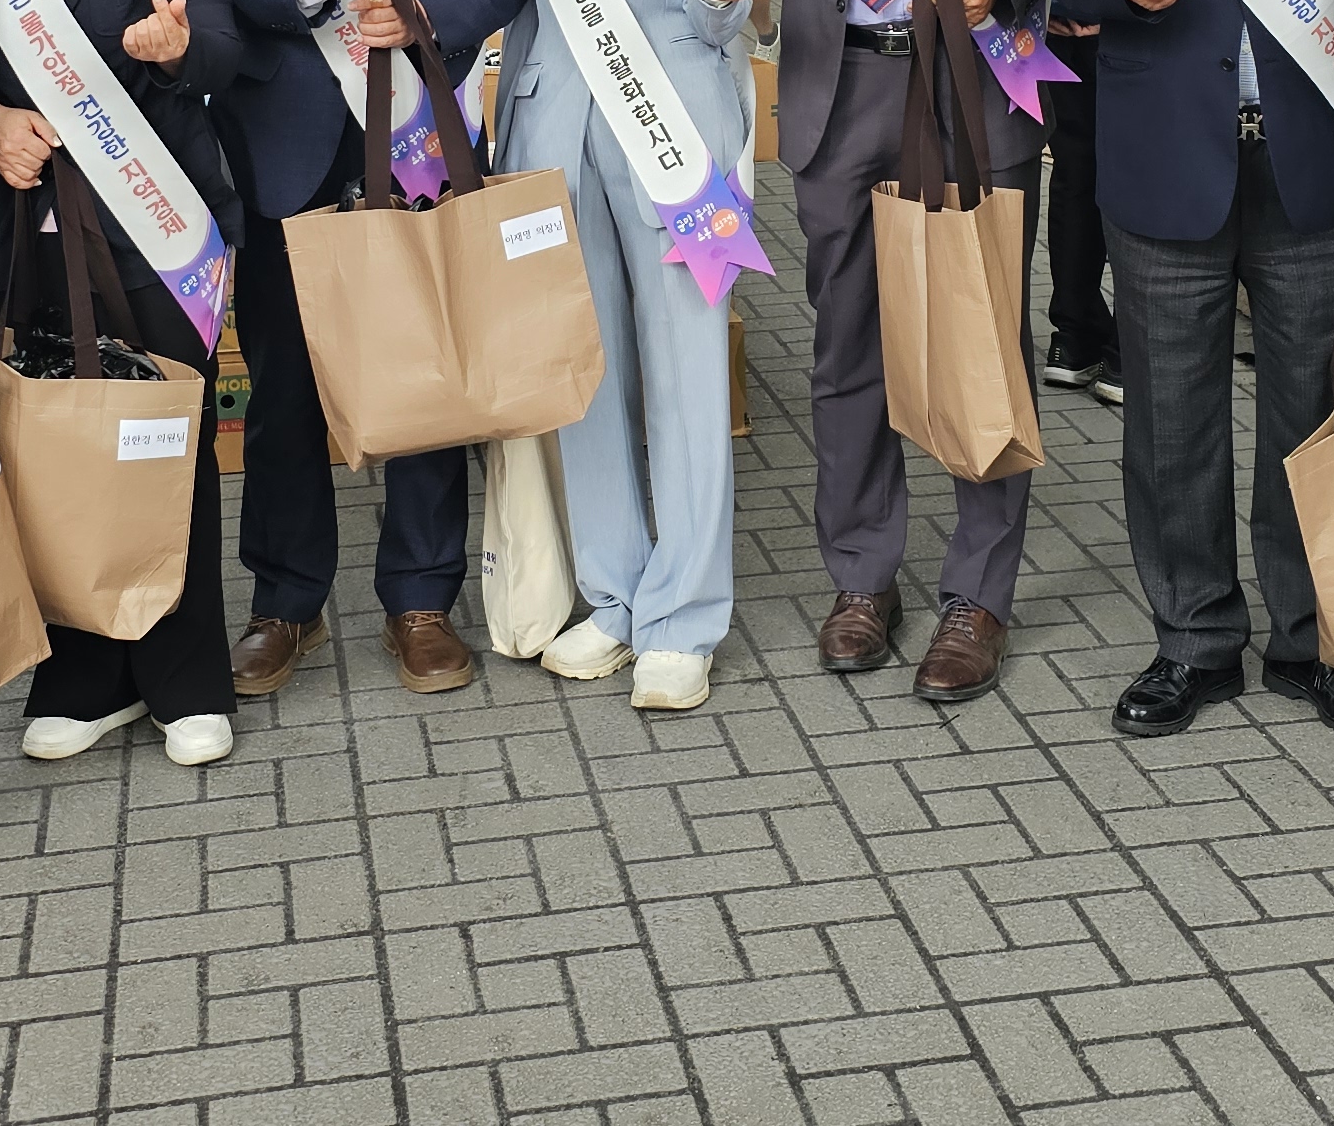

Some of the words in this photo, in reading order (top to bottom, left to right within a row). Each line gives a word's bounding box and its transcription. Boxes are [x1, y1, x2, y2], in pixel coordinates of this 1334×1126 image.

[596, 29, 686, 172] 생활화합시다
[18, 10, 86, 97] 물가안정
[73, 94, 129, 160] 건강한
[118, 157, 188, 240] 지역경제
[536, 220, 563, 235] 의장님
[677, 214, 695, 233] 군민
[695, 202, 717, 222] 중심!
[697, 226, 712, 242] 소통
[714, 212, 738, 233] 의정!
[157, 431, 186, 444] 의원님
